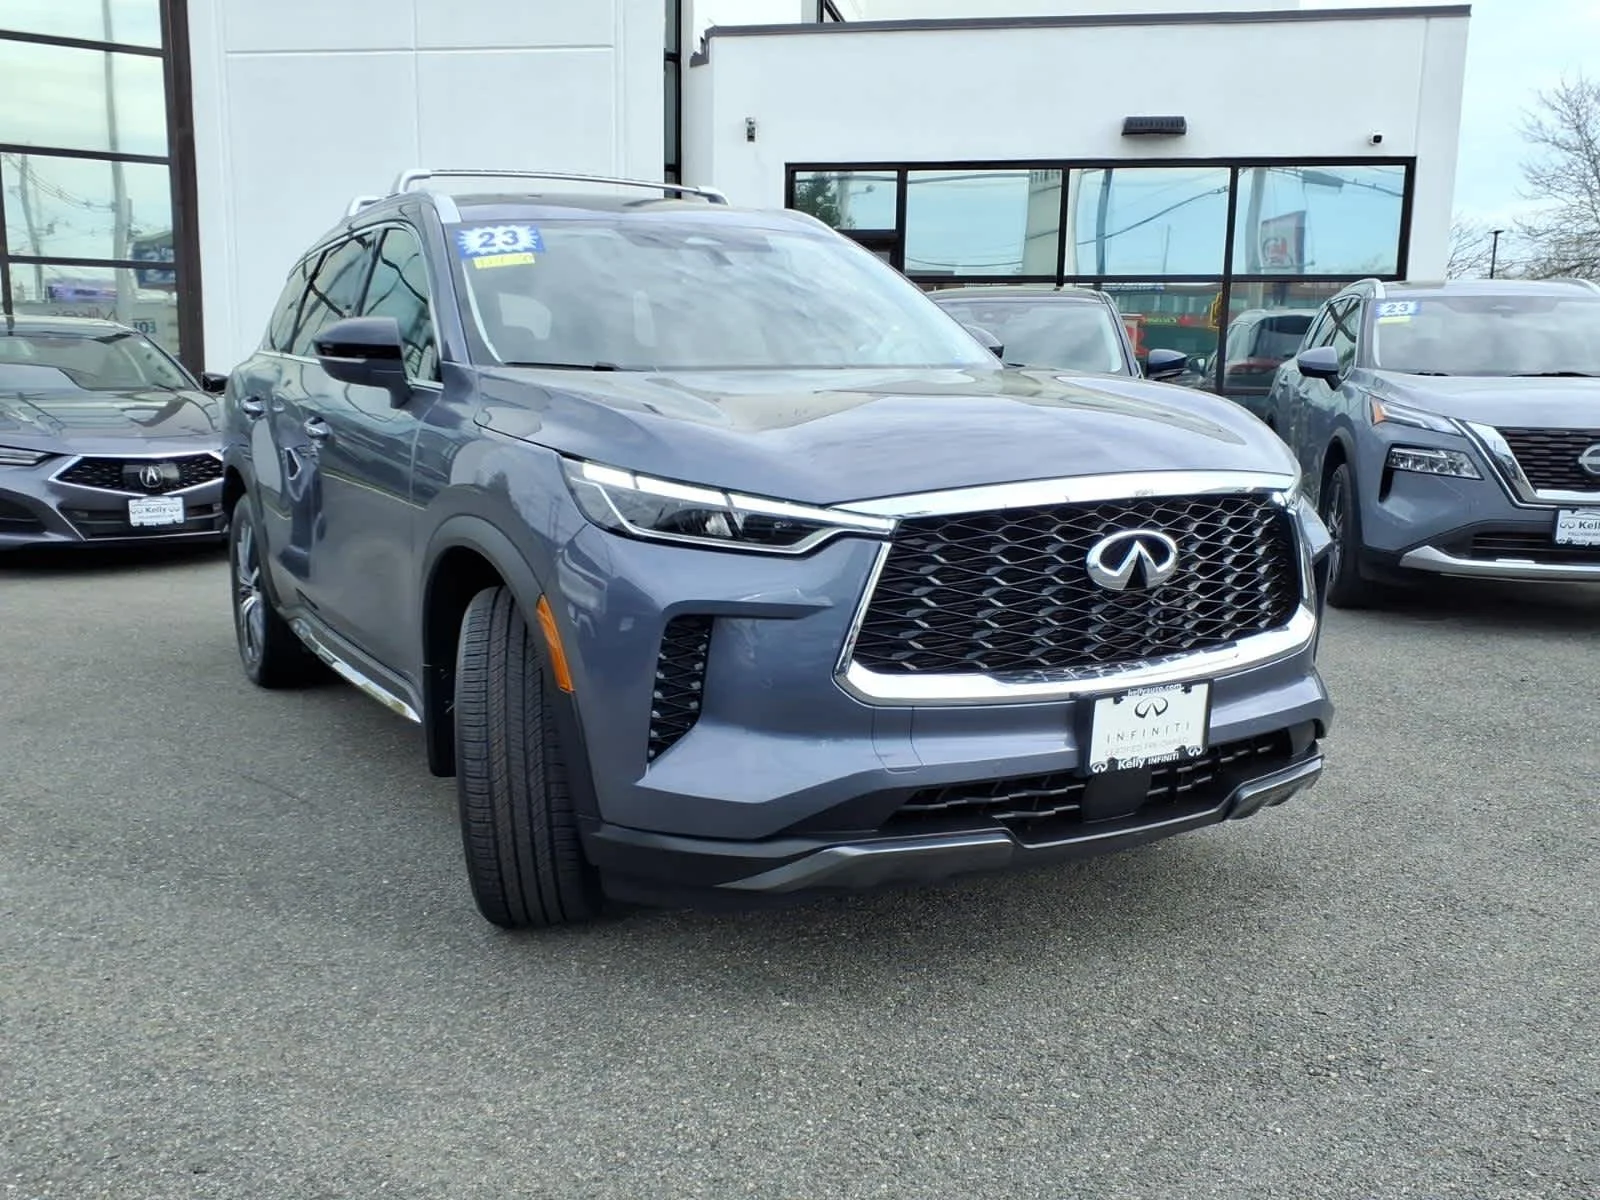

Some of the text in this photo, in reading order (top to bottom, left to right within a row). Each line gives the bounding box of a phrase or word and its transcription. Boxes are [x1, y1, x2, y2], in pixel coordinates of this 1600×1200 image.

[478, 230, 520, 249] 23
[1385, 303, 1409, 313] 23
[1106, 722, 1190, 744] INFINITI
[1118, 752, 1180, 771] Kelly INFINITI
